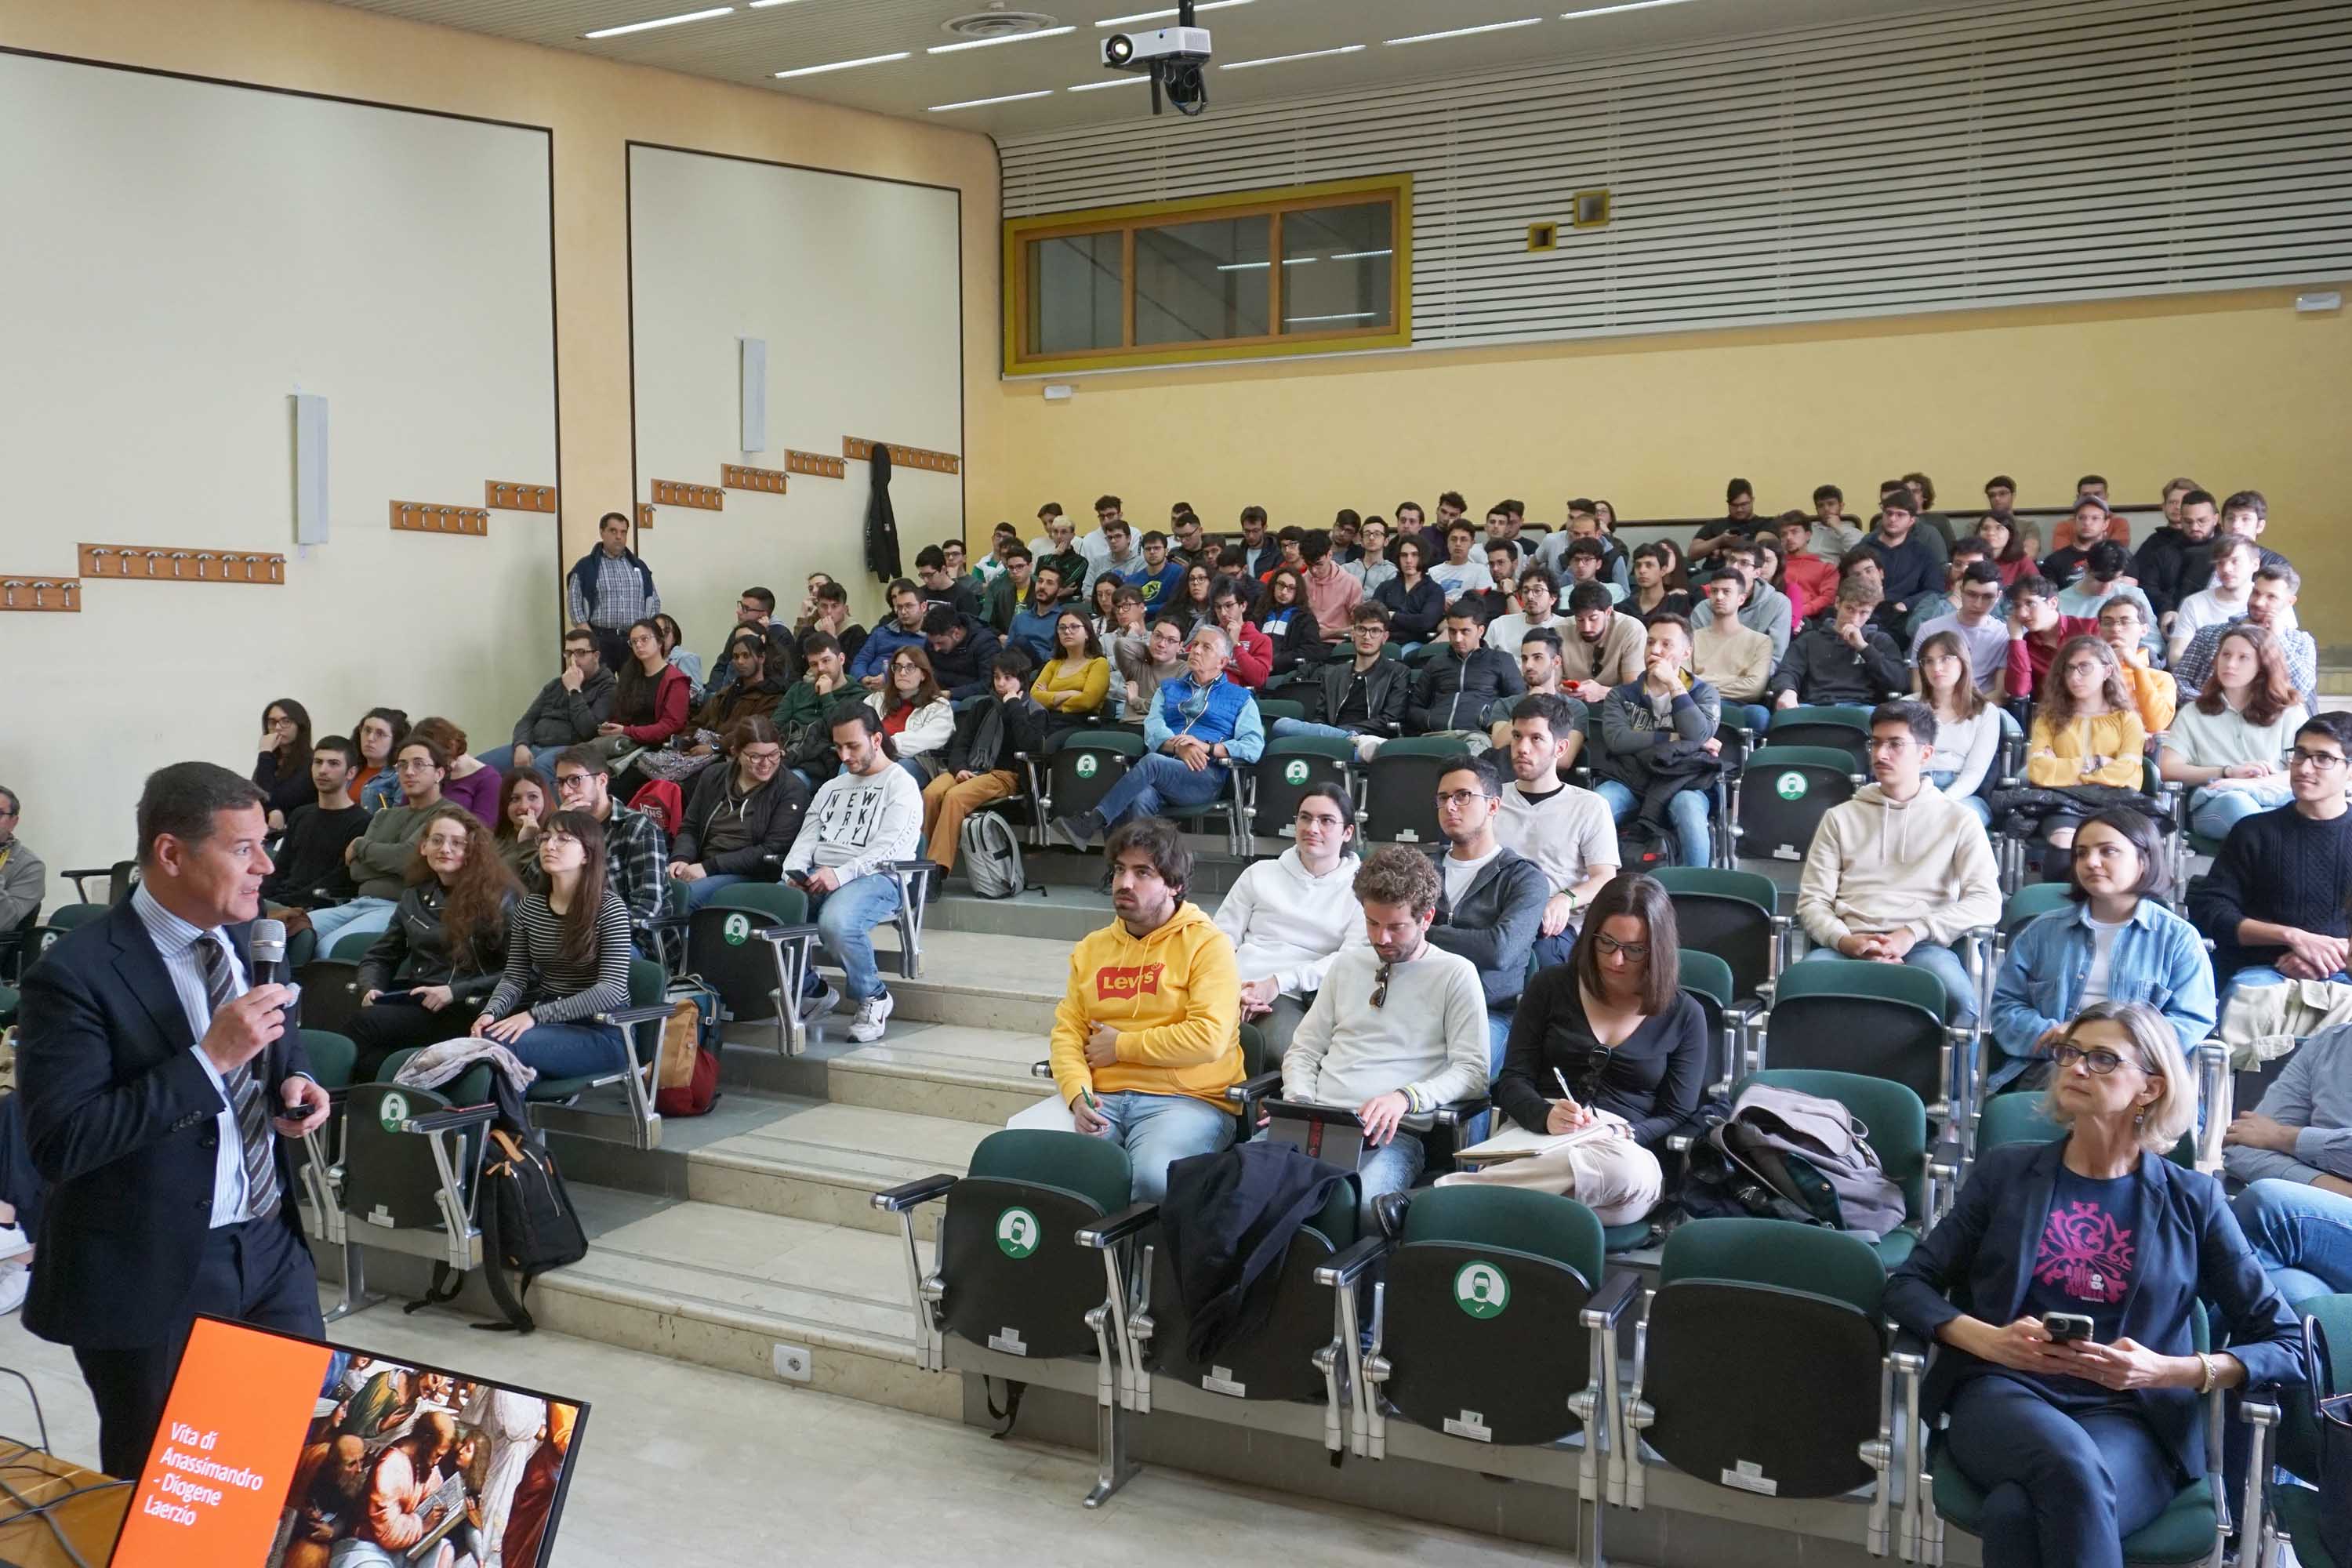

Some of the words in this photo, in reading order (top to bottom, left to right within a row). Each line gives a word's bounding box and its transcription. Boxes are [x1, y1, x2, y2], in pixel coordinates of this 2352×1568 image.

[639, 802, 663, 818] VANS
[170, 1421, 199, 1447] Vita
[200, 1429, 220, 1451] di
[159, 1446, 265, 1492] Anassimandro
[162, 1472, 223, 1507] Diogene
[143, 1494, 198, 1526] Laerzio
